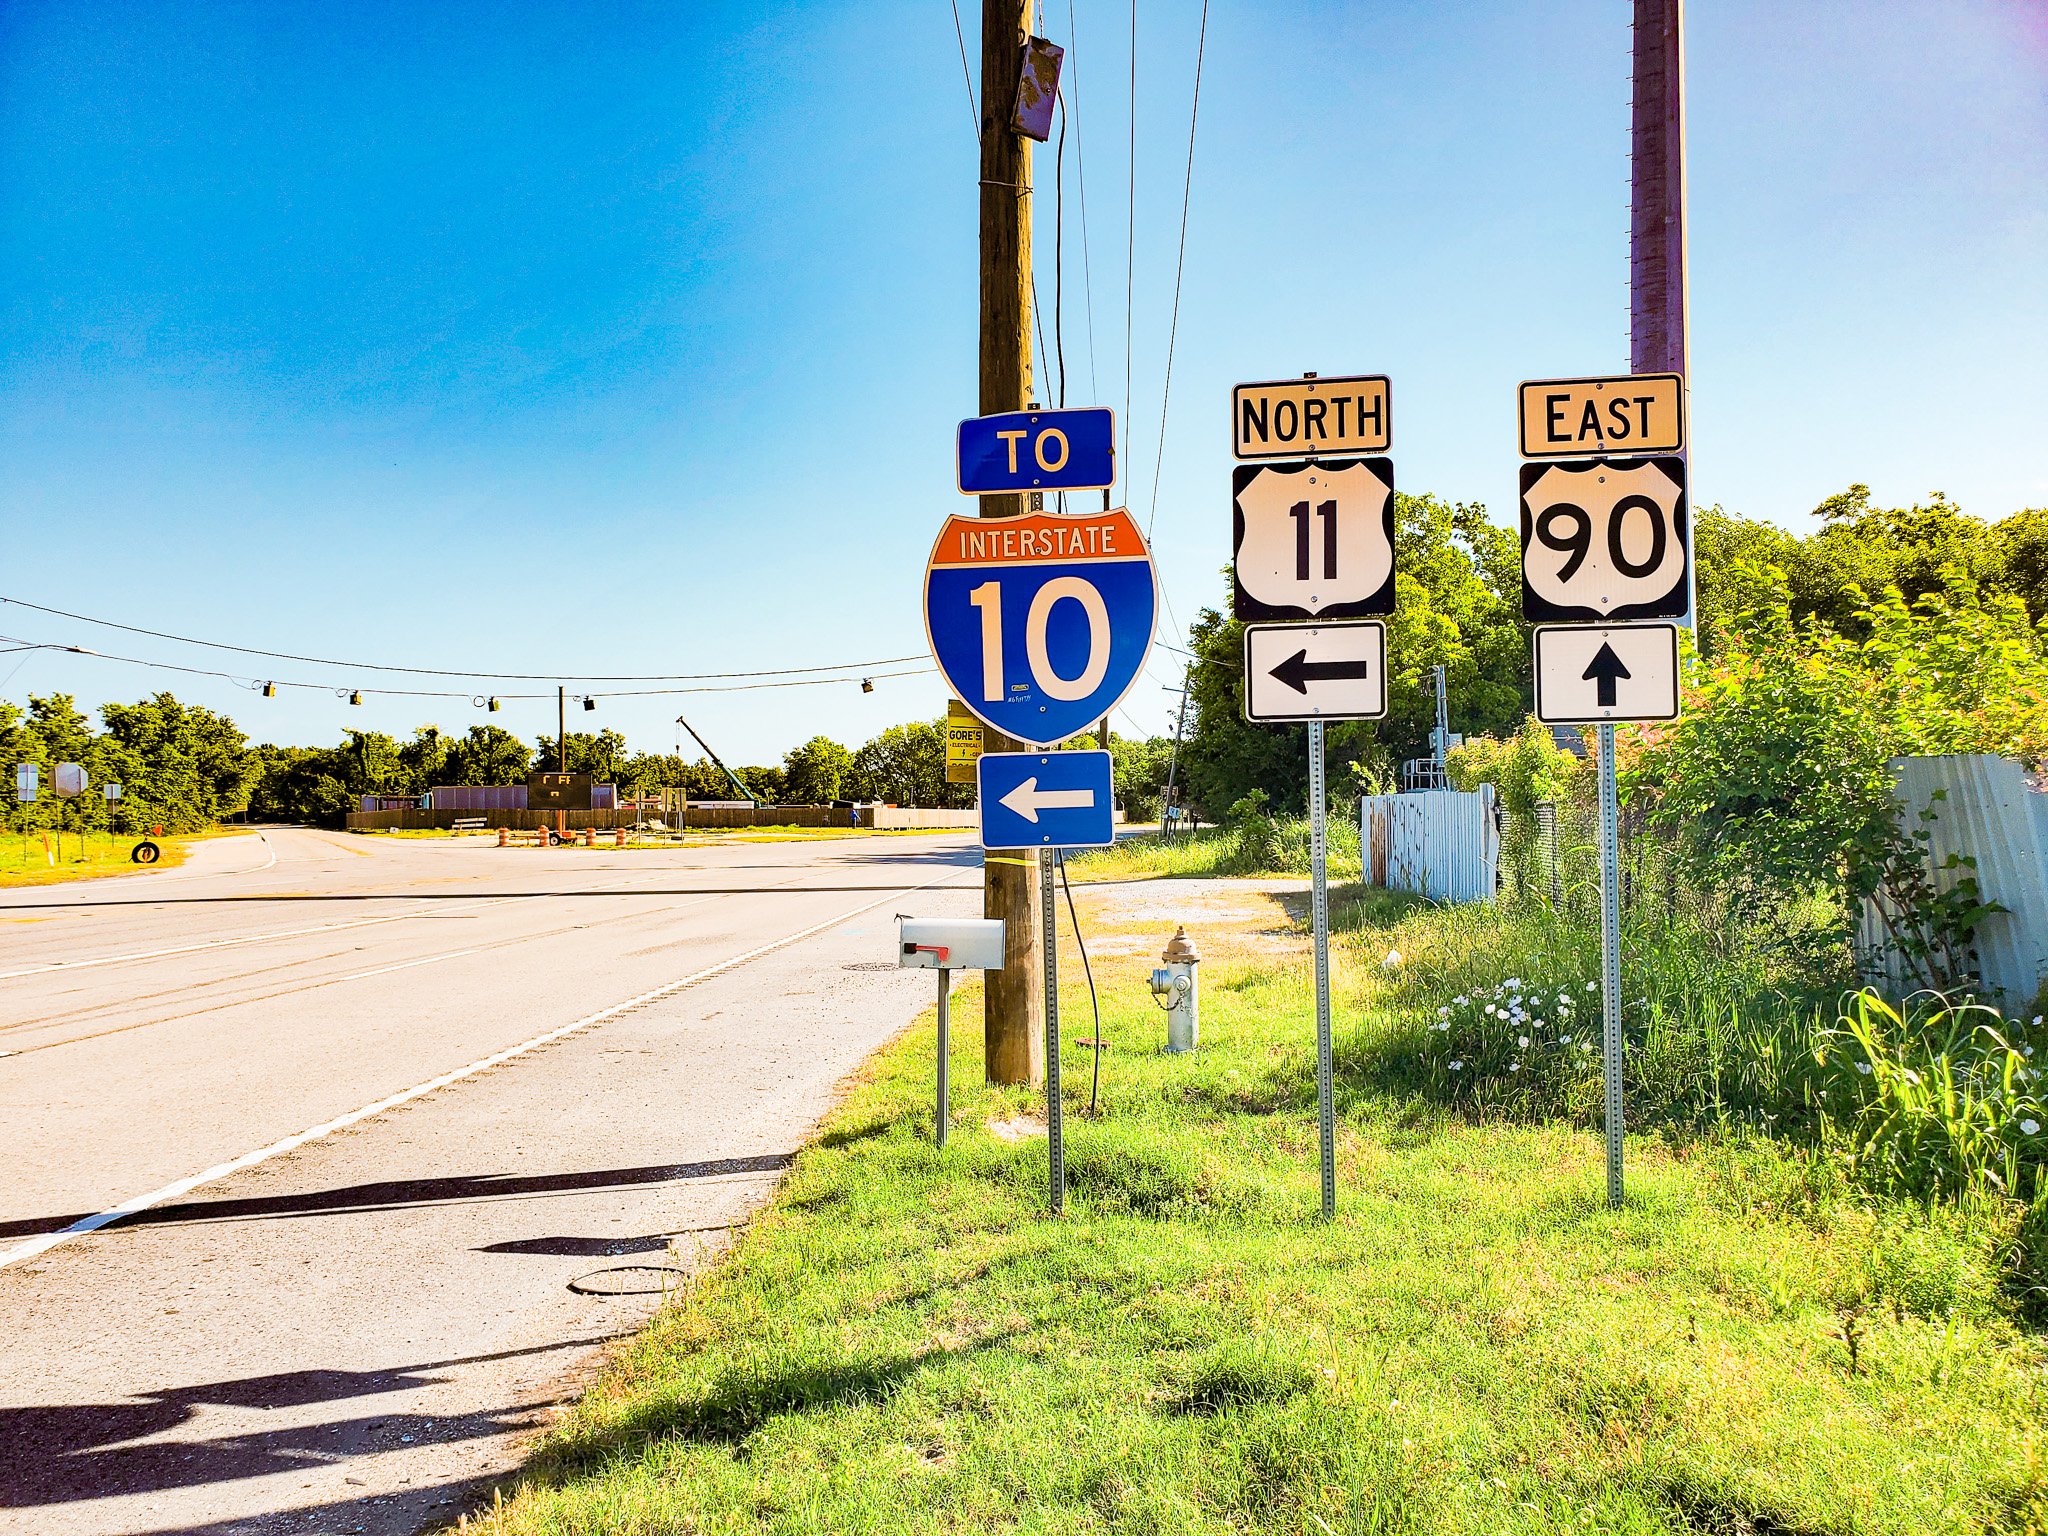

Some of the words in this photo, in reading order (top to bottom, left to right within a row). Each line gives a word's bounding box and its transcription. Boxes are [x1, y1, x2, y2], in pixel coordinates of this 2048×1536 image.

[1241, 393, 1382, 444] NORTH
[1545, 393, 1656, 442] EAST
[996, 428, 1070, 474] TO
[960, 525, 1117, 560] INTERSTATE
[1289, 499, 1338, 581] 11
[1535, 494, 1667, 584] 90
[969, 576, 1113, 703] 10
[949, 730, 982, 741] GORE'S
